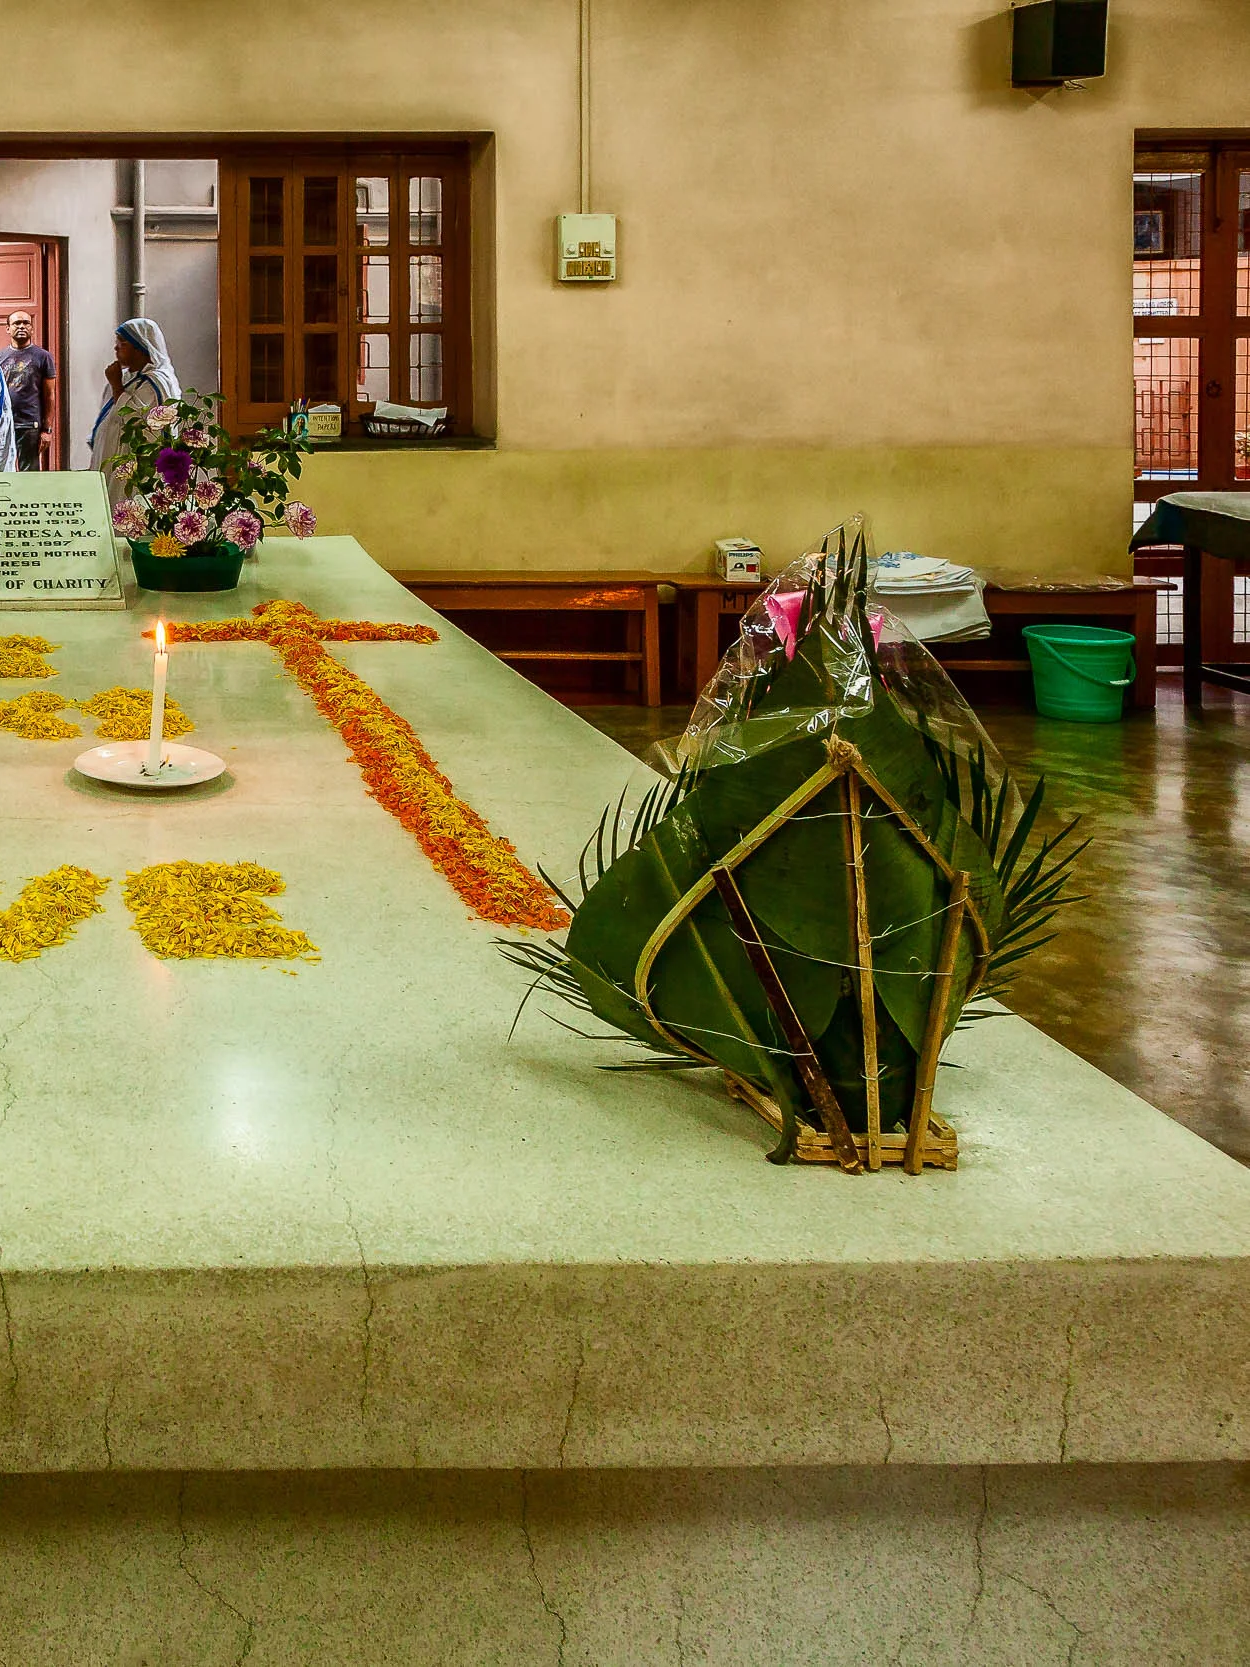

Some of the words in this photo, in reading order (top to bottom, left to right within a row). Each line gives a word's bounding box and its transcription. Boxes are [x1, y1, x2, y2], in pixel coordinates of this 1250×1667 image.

[70, 530, 101, 538] M.C.
[44, 550, 97, 558] MOTHER
[5, 579, 25, 589] OF
[32, 578, 108, 590] CHARITY
